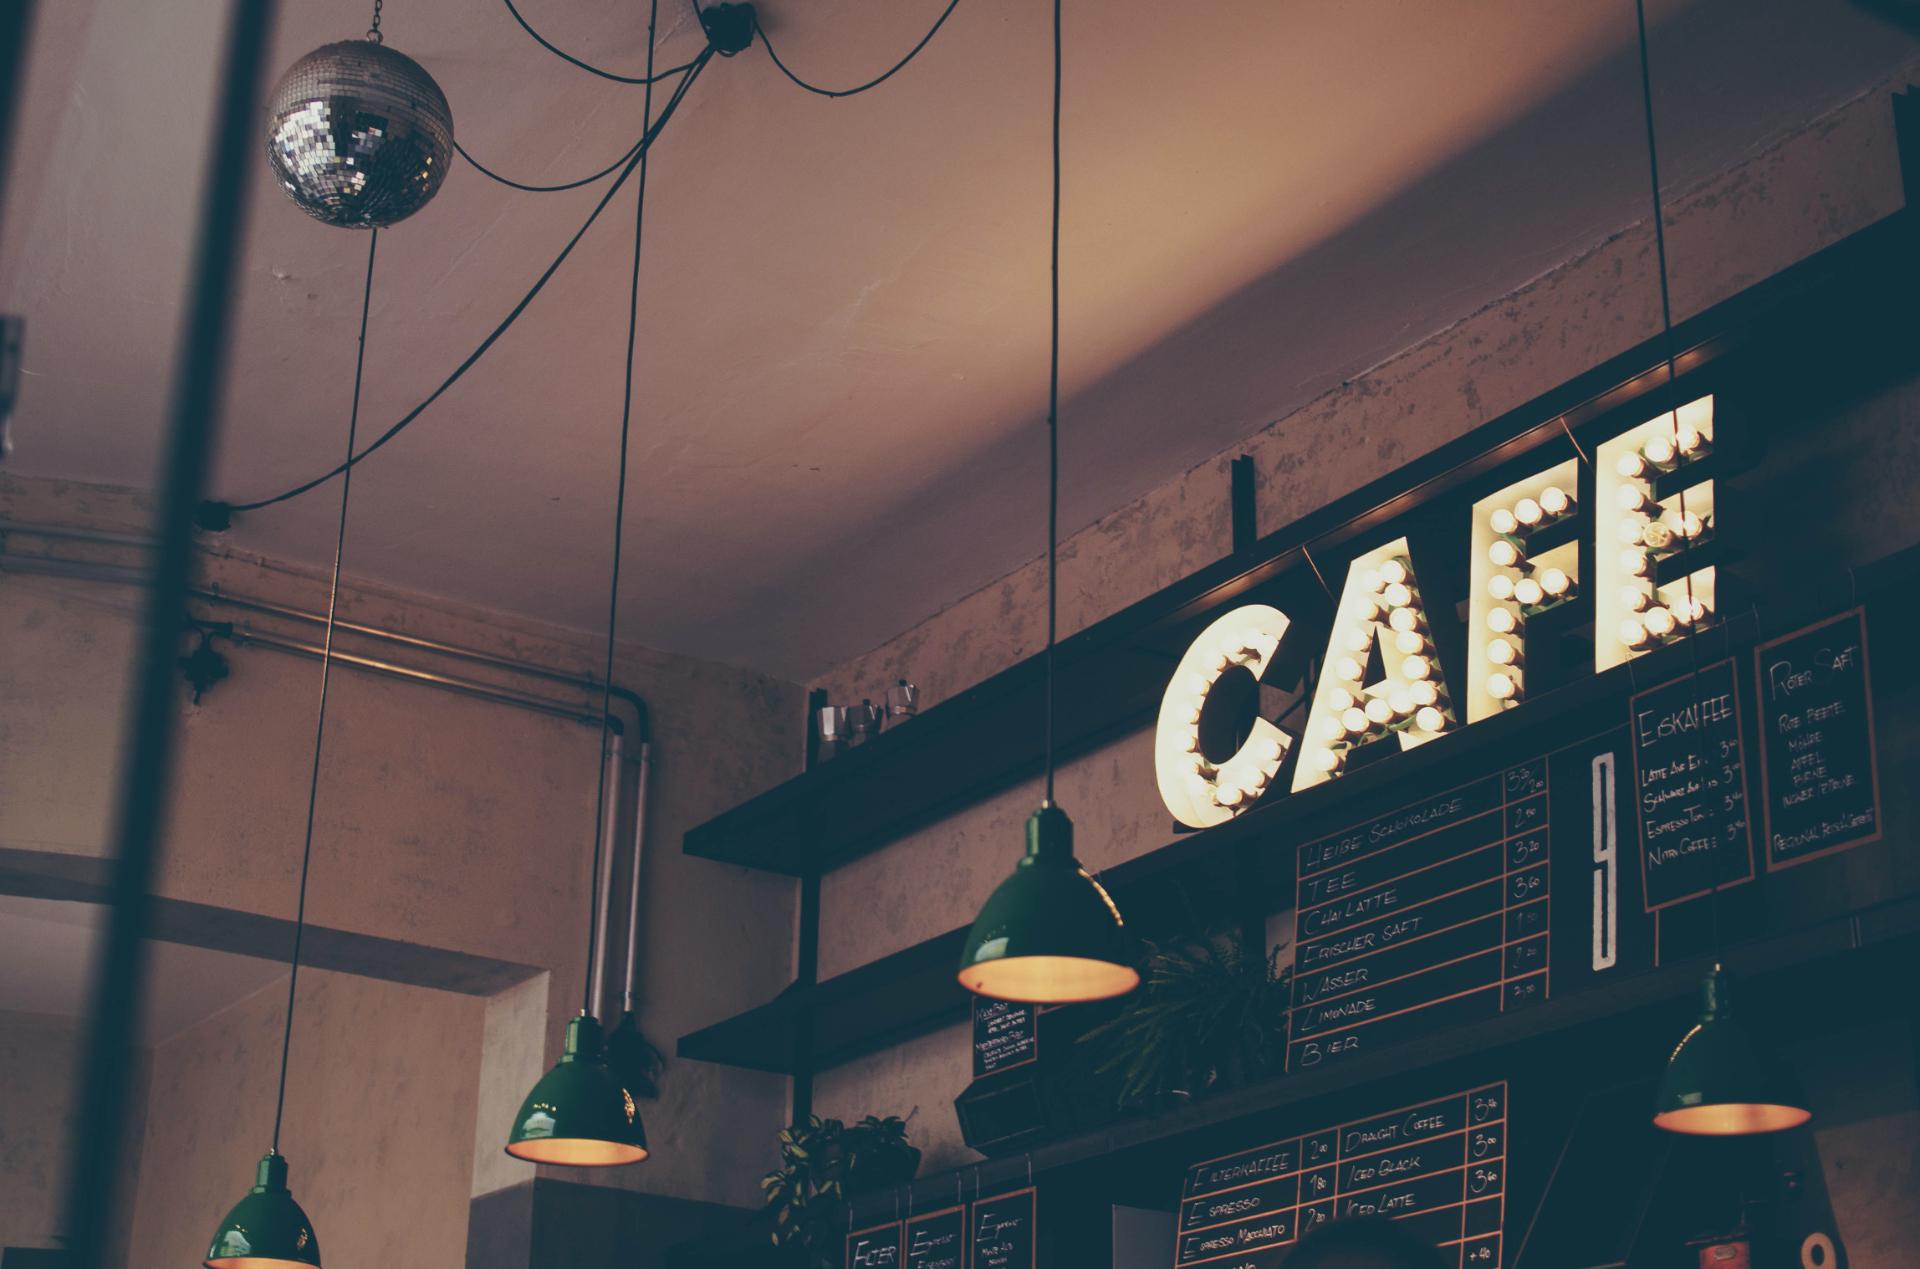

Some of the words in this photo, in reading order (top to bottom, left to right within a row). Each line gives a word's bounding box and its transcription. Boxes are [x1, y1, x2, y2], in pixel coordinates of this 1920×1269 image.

[1155, 393, 1716, 829] CAFE
[1688, 755, 1708, 770] EI
[1308, 872, 1357, 902] TEE
[1345, 889, 1399, 917] LATTE
[1382, 917, 1423, 941] SAFT
[1302, 968, 1368, 1003] WASSER
[1300, 1036, 1359, 1067] BIER
[1402, 1113, 1446, 1137] COFFEE
[1378, 1156, 1421, 1177] BLACK
[1187, 1197, 1260, 1227] ESPRESSO
[1377, 1193, 1416, 1214] LATTE
[1183, 1237, 1234, 1260] ESPRESSO
